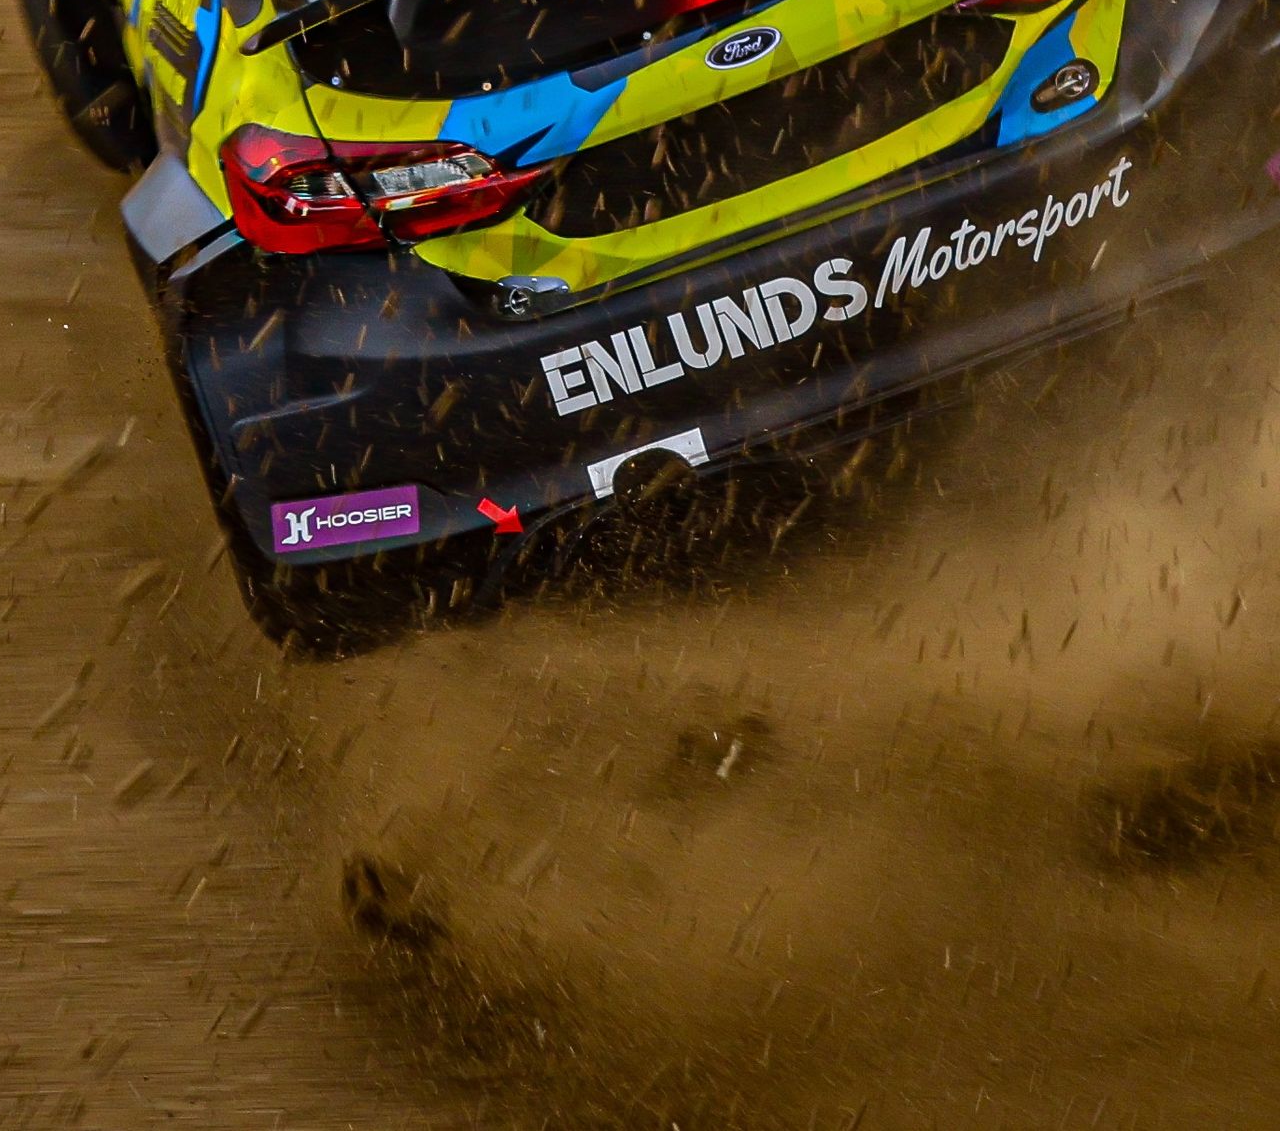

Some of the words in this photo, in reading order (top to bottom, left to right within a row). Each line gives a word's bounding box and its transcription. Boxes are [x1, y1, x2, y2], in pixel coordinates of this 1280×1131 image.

[723, 35, 762, 62] Ford
[540, 258, 868, 416] ENLUNDS
[874, 156, 1132, 308] Motorsport
[316, 504, 412, 530] HOOSIER
